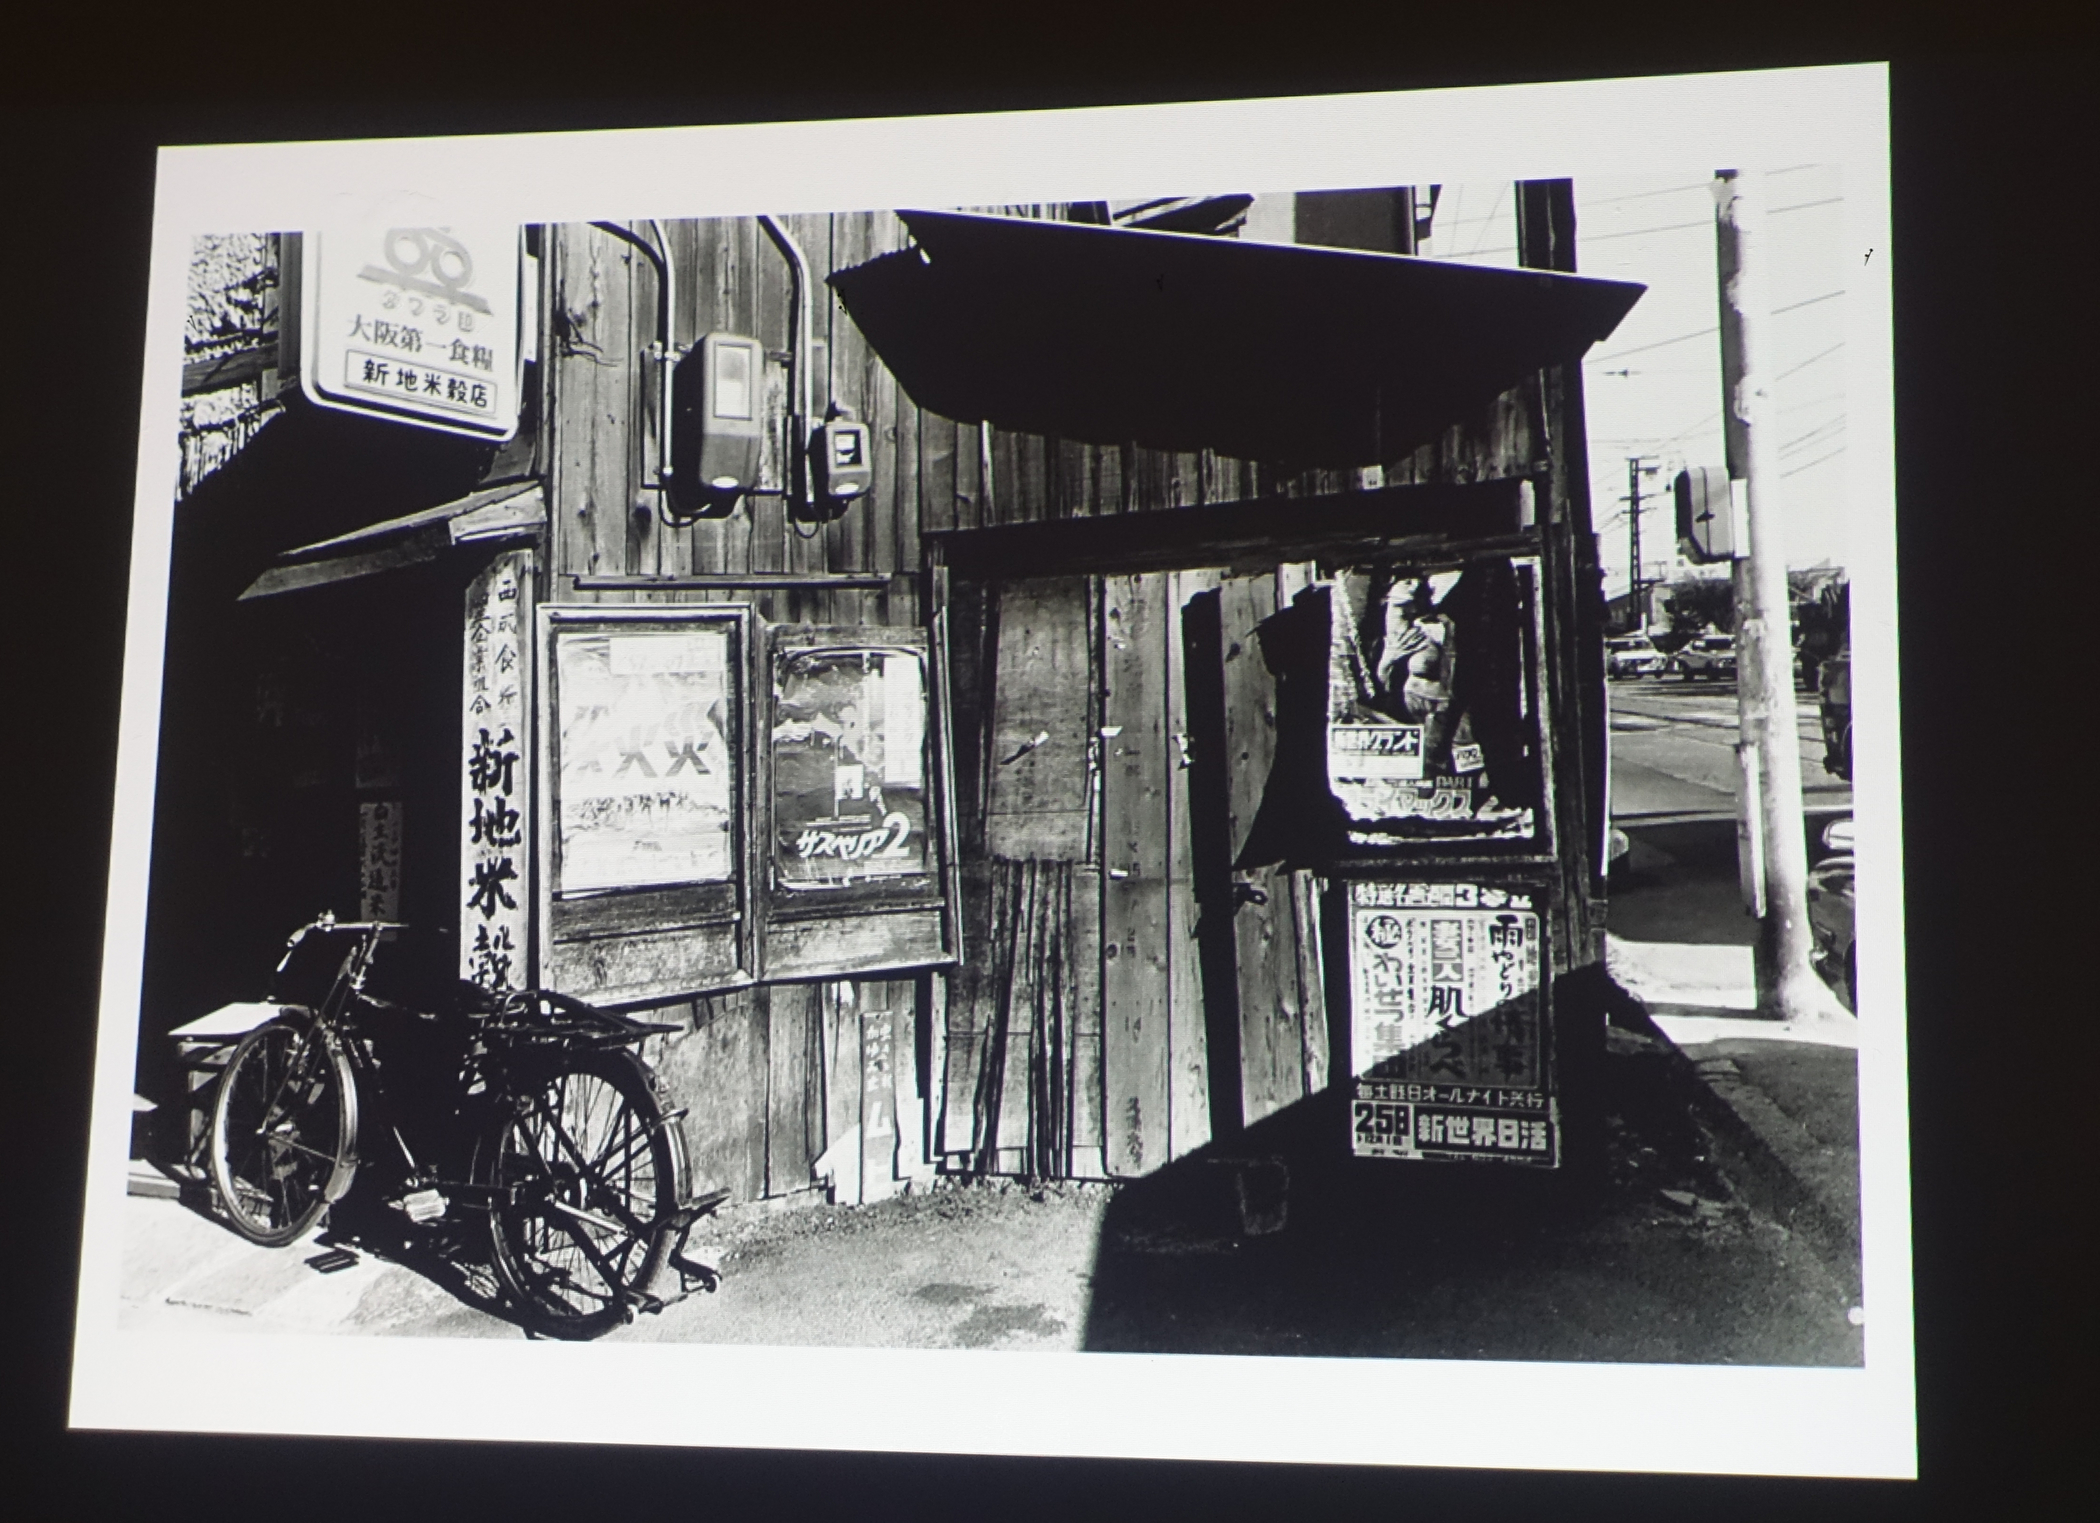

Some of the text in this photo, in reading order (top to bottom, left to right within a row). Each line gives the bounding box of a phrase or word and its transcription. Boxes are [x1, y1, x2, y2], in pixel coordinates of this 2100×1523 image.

[349, 314, 493, 372] 大阪第一食糧
[363, 358, 487, 407] 新地米穀店
[796, 812, 911, 860] サスペリア2
[1418, 1114, 1547, 1151] 新世界日活
